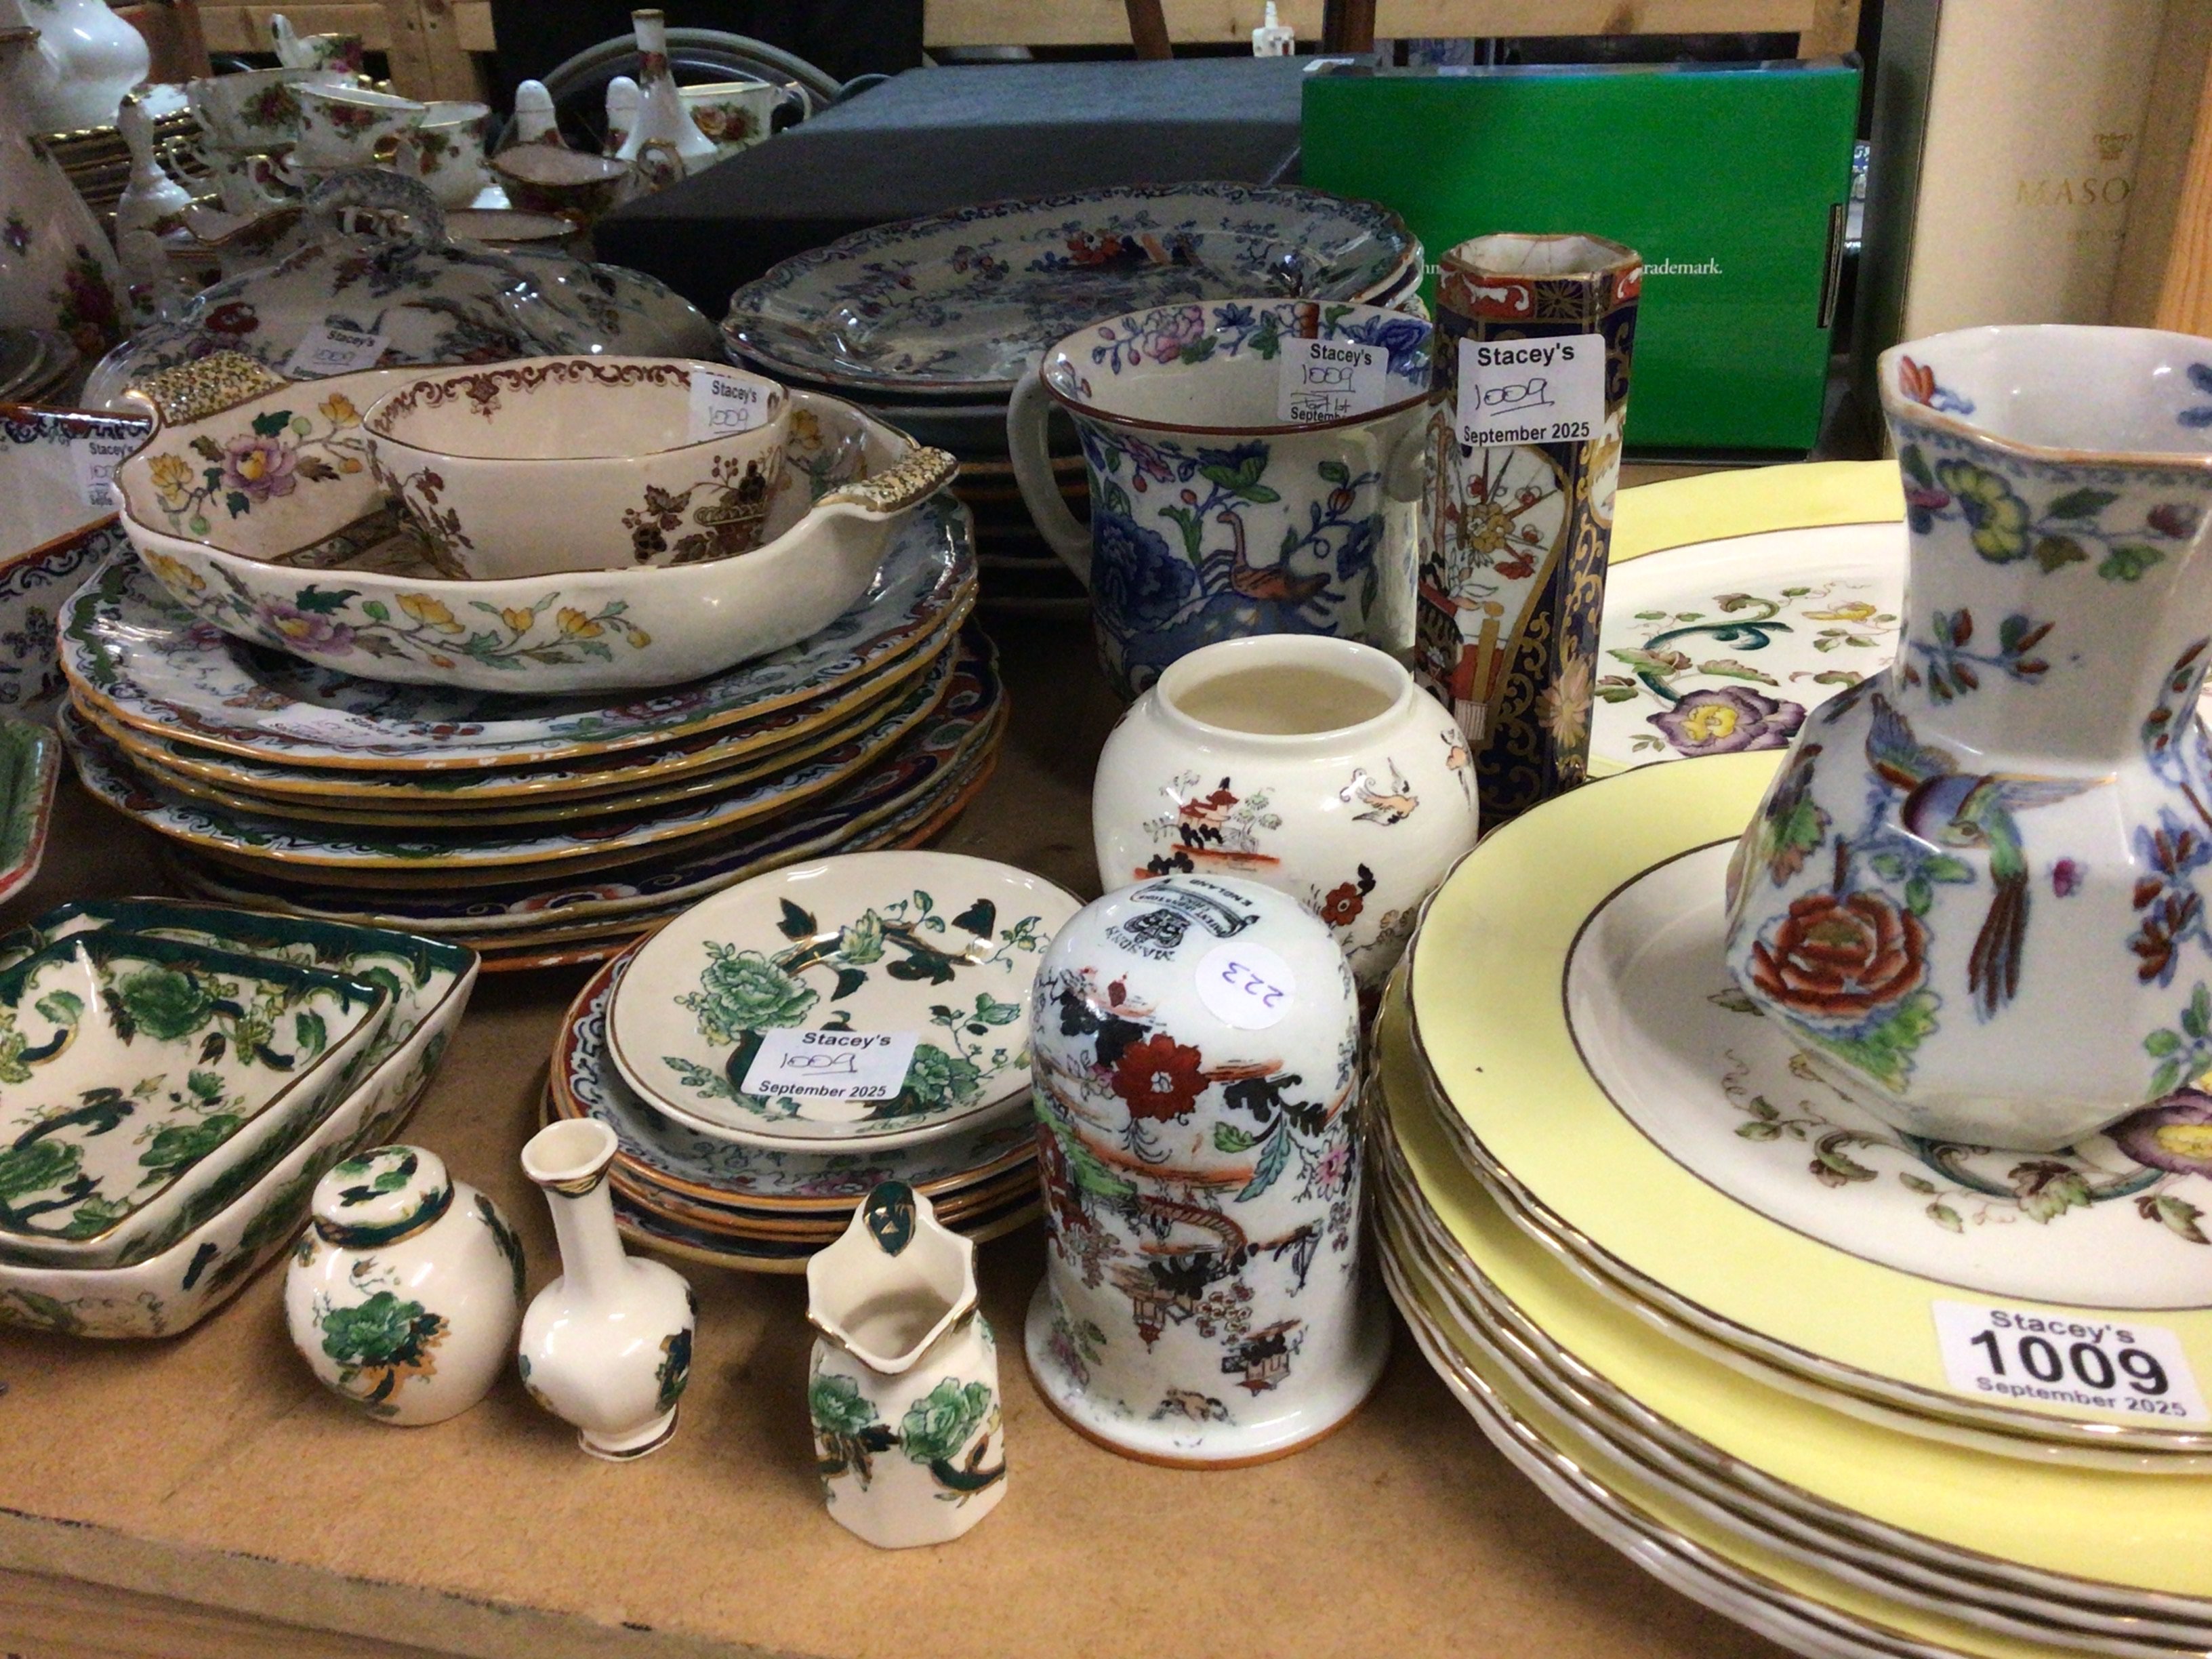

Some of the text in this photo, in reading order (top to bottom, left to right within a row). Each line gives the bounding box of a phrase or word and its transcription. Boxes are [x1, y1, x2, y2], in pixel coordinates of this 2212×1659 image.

[1643, 257, 1723, 274] rademark.
[1310, 343, 1372, 367] Stacey's
[1477, 343, 1574, 367] Stacey's
[1302, 364, 1354, 391] 1009
[712, 380, 757, 404] Stacey's
[1475, 377, 1548, 411] 1009
[708, 407, 749, 430] 1009
[1464, 422, 1590, 447] September 2025
[1189, 879, 1252, 907] ENGLAND
[802, 1032, 891, 1050] Stacey's
[779, 1052, 857, 1073] 1009
[758, 1080, 886, 1098] September 2025
[1990, 1310, 2135, 1344] Stacey's
[1971, 1330, 2169, 1396] 1009
[1976, 1376, 2188, 1418] September 2025
